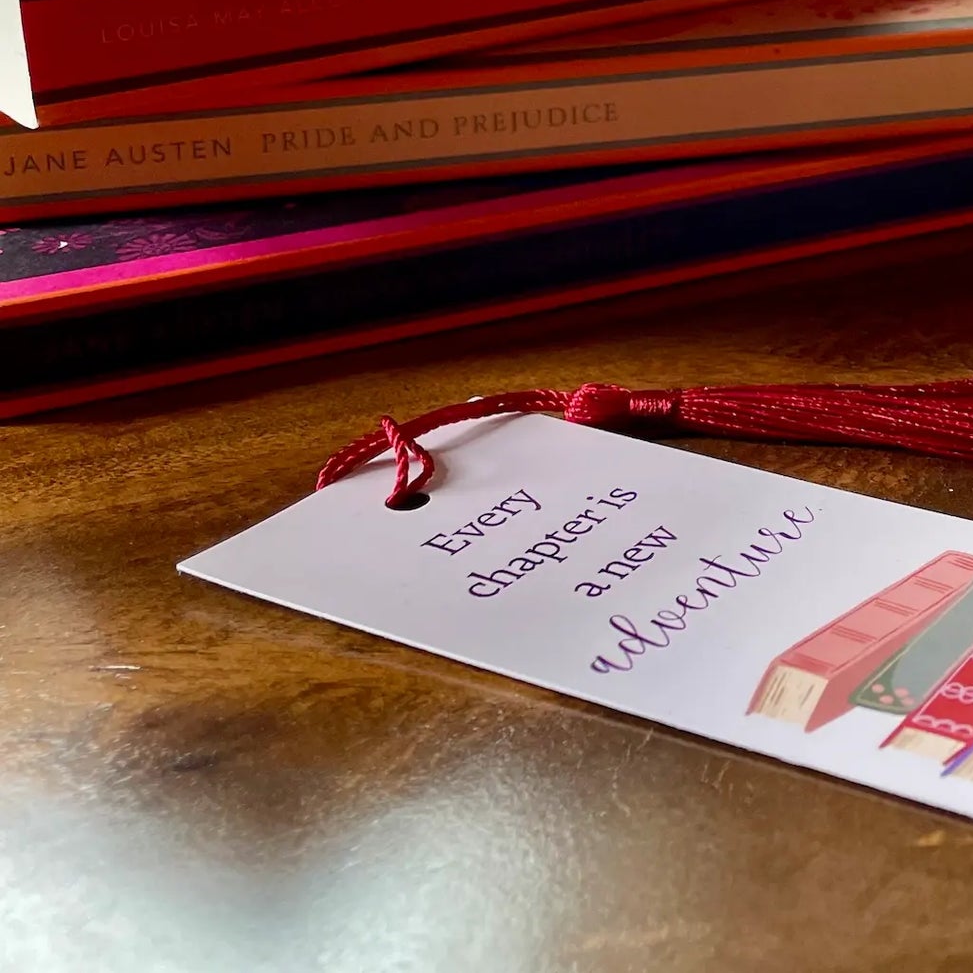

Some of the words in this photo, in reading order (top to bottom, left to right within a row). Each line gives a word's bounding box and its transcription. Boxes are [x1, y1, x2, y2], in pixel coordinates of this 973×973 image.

[101, 13, 198, 43] LOUISA
[213, 4, 265, 26] MAY
[4, 150, 88, 177] JANE
[104, 137, 231, 167] AUSTEN
[261, 126, 356, 153] PRIDE
[370, 118, 440, 143] AND
[453, 102, 620, 137] PREJUDICE
[420, 488, 542, 557] Every
[467, 507, 607, 598] chapter
[586, 486, 638, 511] is
[574, 580, 611, 598] a
[598, 525, 679, 580] new
